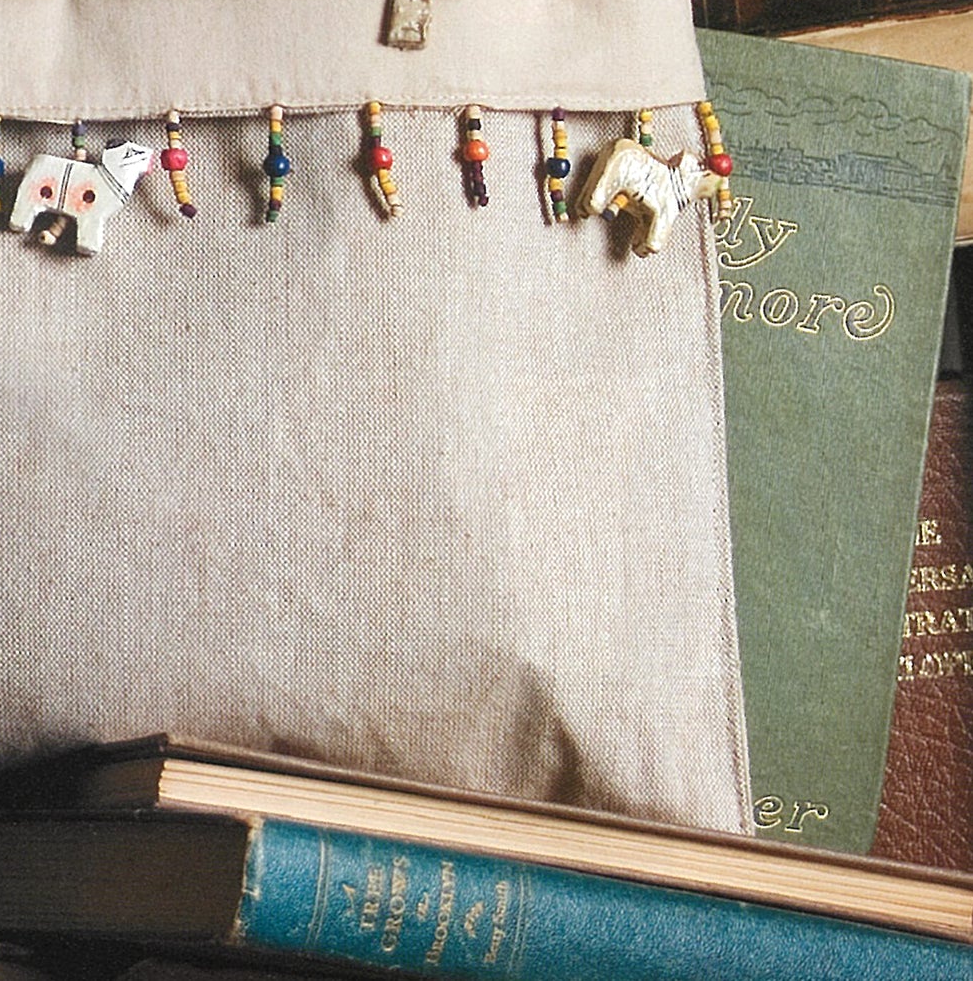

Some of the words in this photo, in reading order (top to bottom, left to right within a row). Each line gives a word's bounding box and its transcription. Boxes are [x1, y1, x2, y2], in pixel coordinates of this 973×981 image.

[359, 864, 385, 932] TREE
[380, 855, 410, 952] GROWS
[425, 861, 455, 965] BROOKLYN
